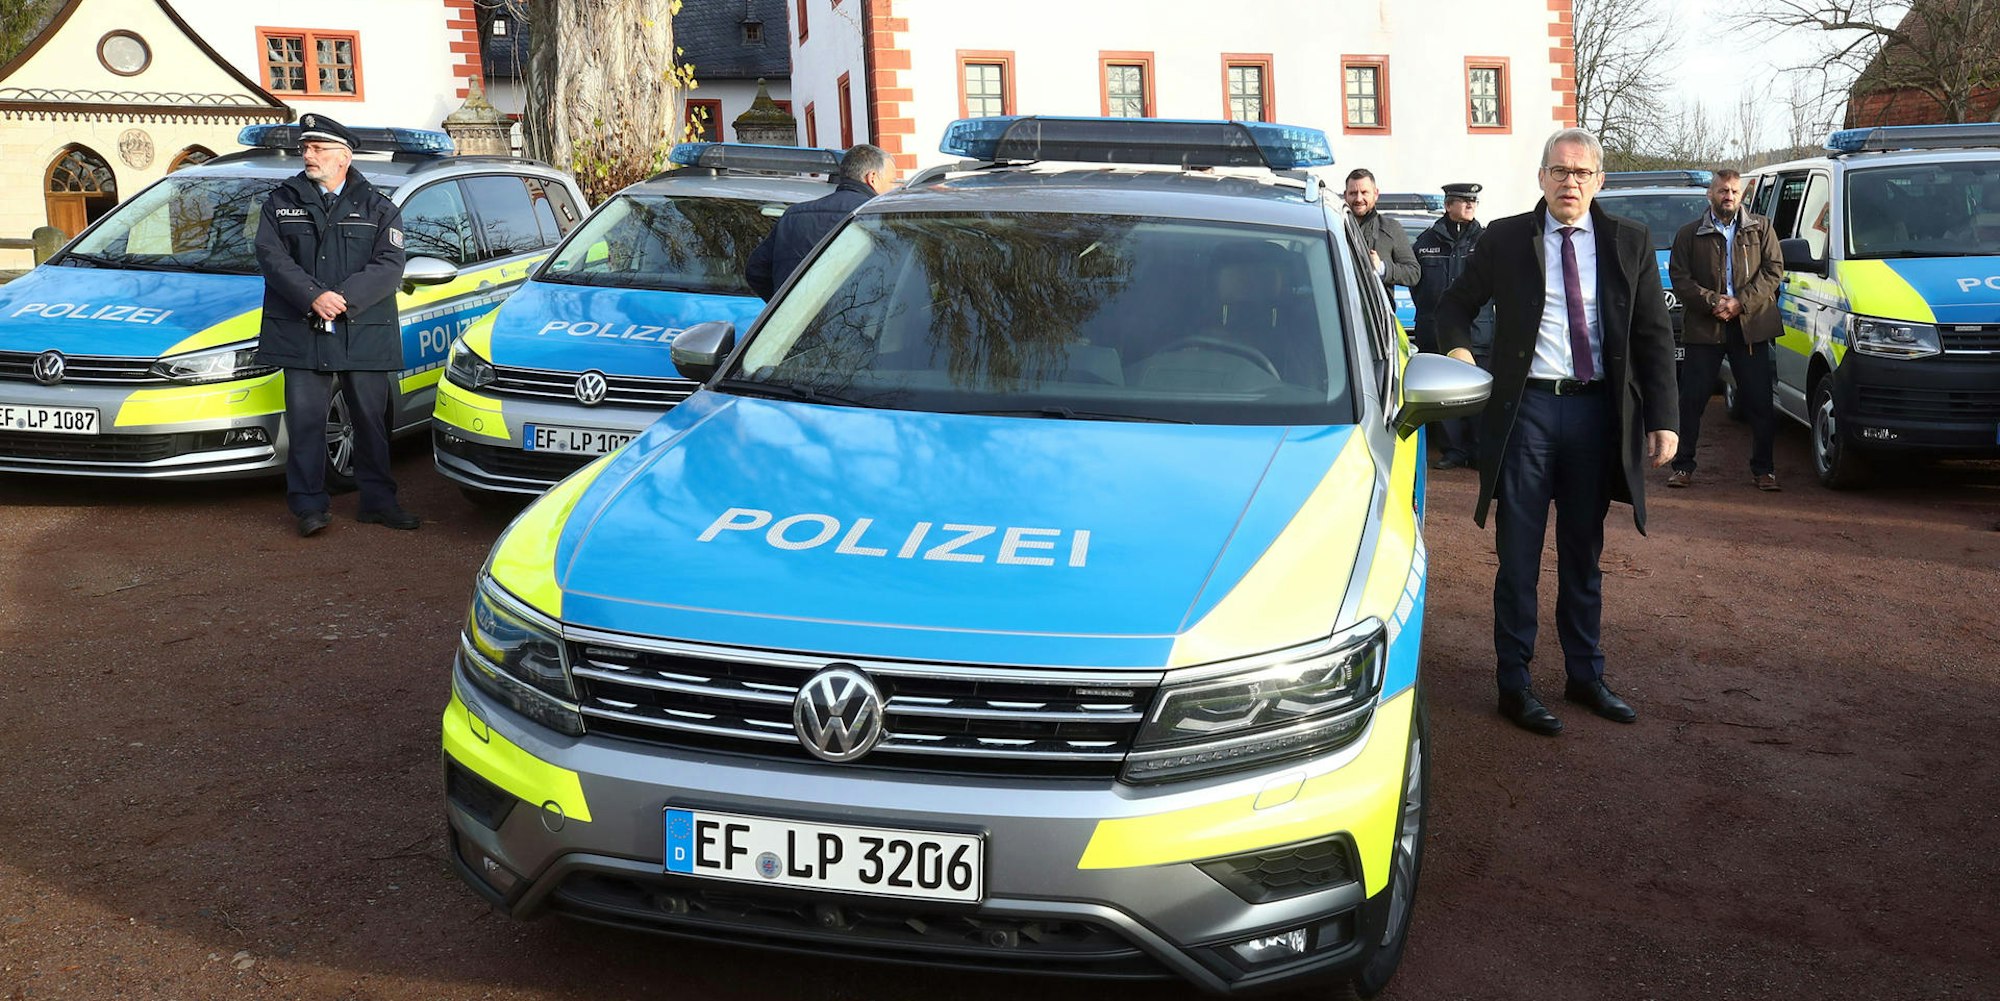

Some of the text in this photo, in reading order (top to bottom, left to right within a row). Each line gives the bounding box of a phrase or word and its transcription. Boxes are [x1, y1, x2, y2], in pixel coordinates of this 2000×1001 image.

[10, 303, 174, 325] POLIZEI
[538, 321, 686, 343] POLIZE
[28, 409, 48, 428] LP
[54, 411, 95, 431] 1087
[535, 429, 637, 453] EF LP 107
[697, 507, 1091, 568] POLIZEI
[674, 847, 686, 861] D
[696, 820, 973, 891] EF LP 3206
